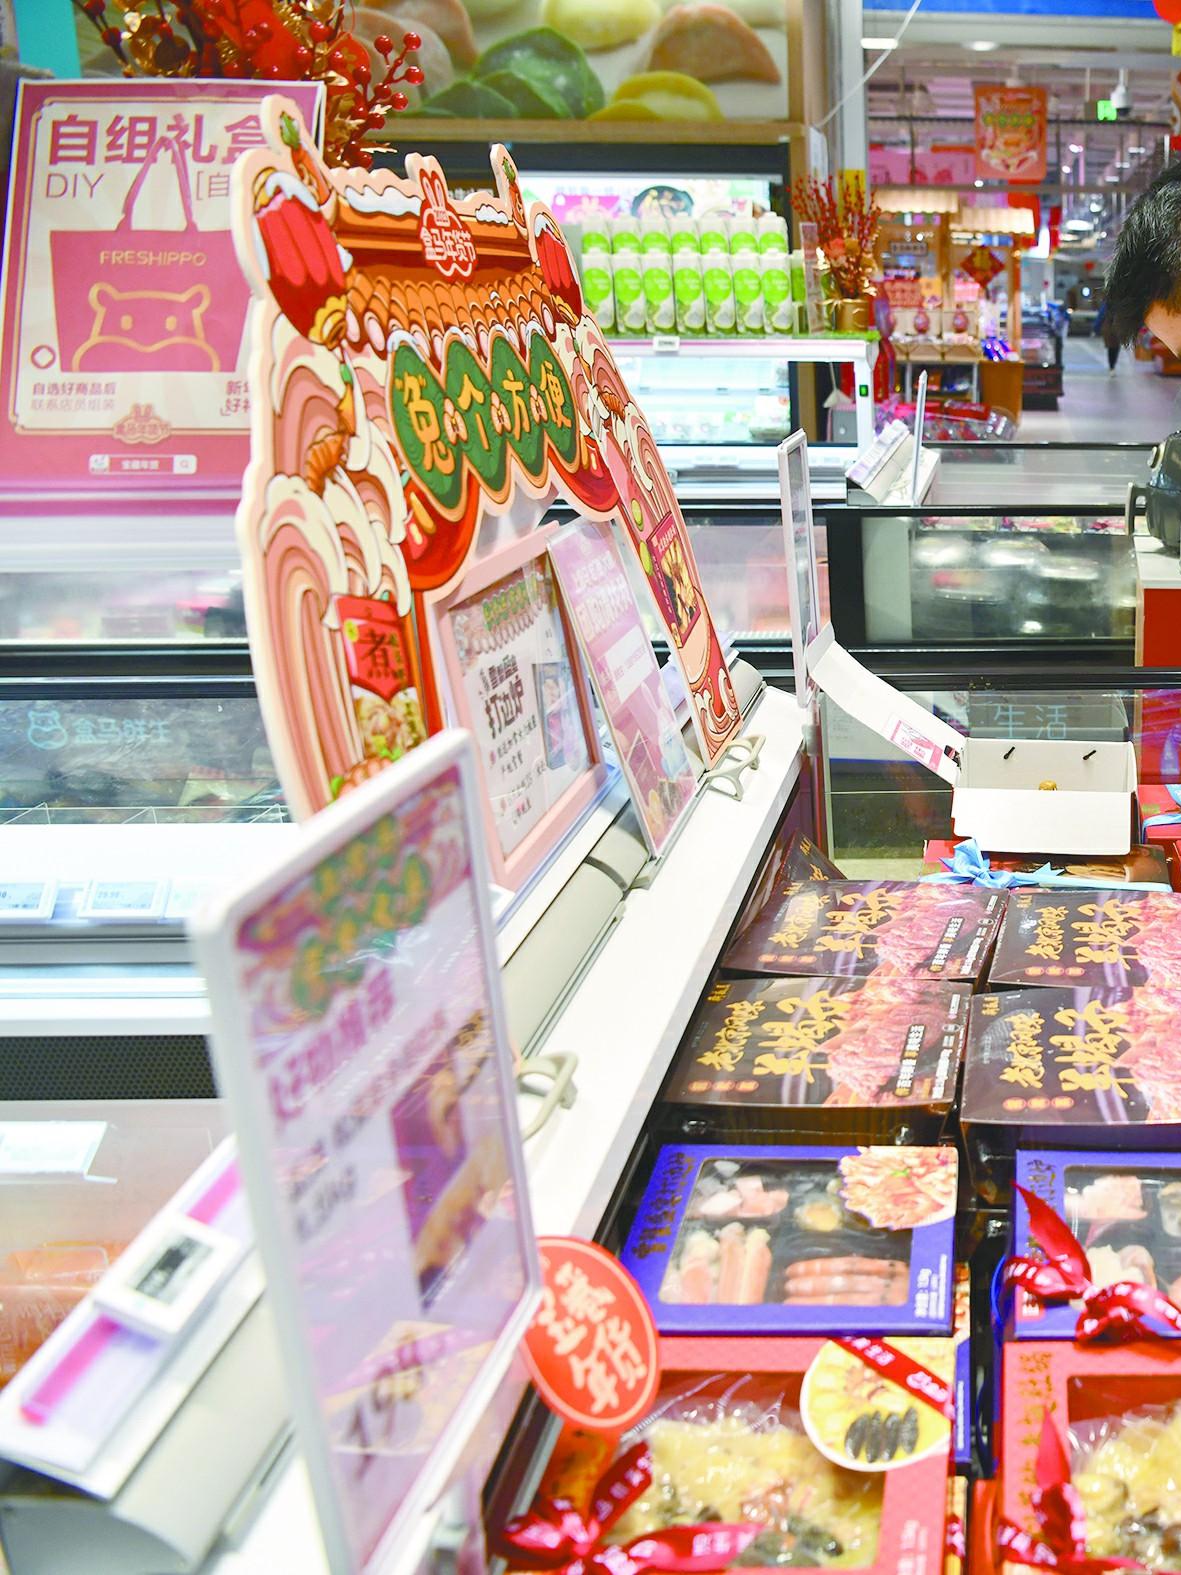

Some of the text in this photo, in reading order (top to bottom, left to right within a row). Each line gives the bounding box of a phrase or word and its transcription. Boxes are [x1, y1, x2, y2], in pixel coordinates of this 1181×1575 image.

[49, 114, 268, 166] 自组礼盒
[45, 173, 104, 199] DIY
[100, 250, 207, 266] FRESHIPPO
[358, 629, 390, 678] 煮
[993, 704, 1068, 739] 生活
[752, 990, 853, 1084] 羊蝎子
[1049, 999, 1138, 1100] 羊蝎子
